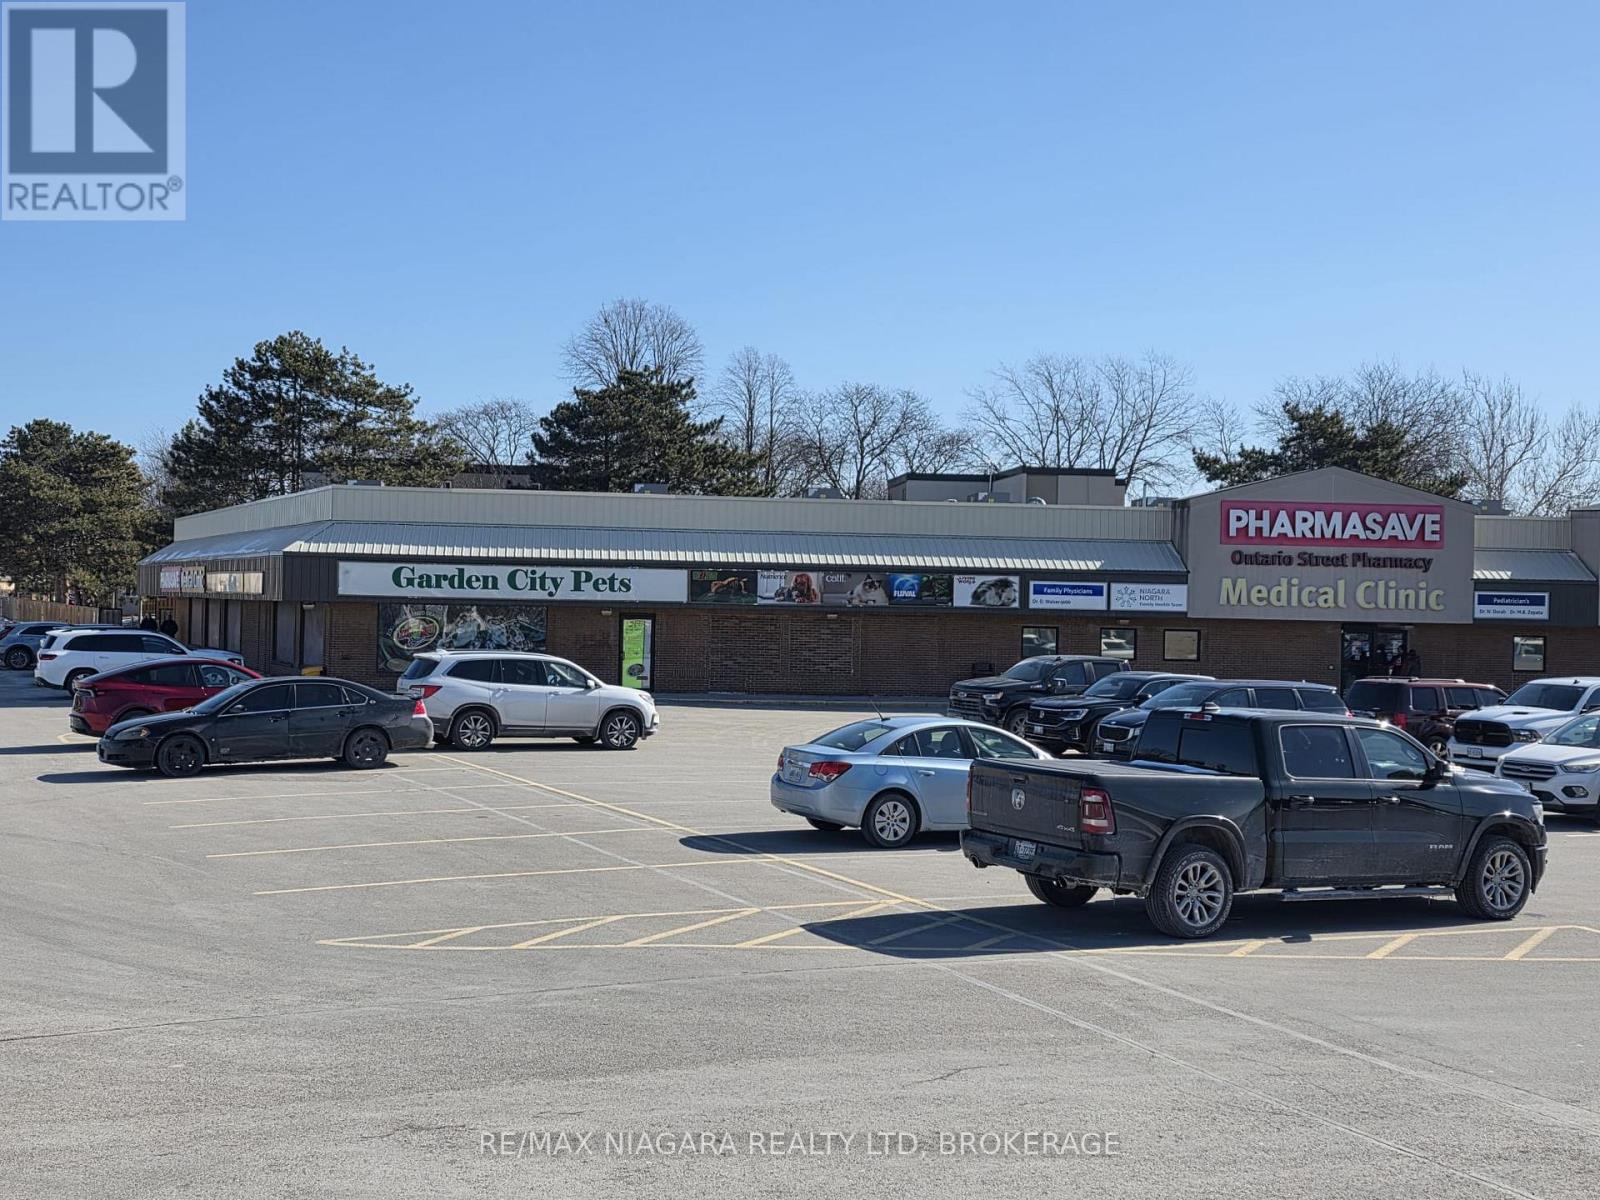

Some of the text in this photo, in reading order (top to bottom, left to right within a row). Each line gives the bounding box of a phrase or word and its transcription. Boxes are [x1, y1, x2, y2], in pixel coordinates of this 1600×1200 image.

[1228, 508, 1441, 542] PHARMASAVE
[1230, 550, 1434, 573] Ontario Street Pharmacy
[391, 565, 632, 598] Garden City Pets
[1064, 587, 1093, 595] Physicians
[1219, 576, 1445, 611] Medical Clinic
